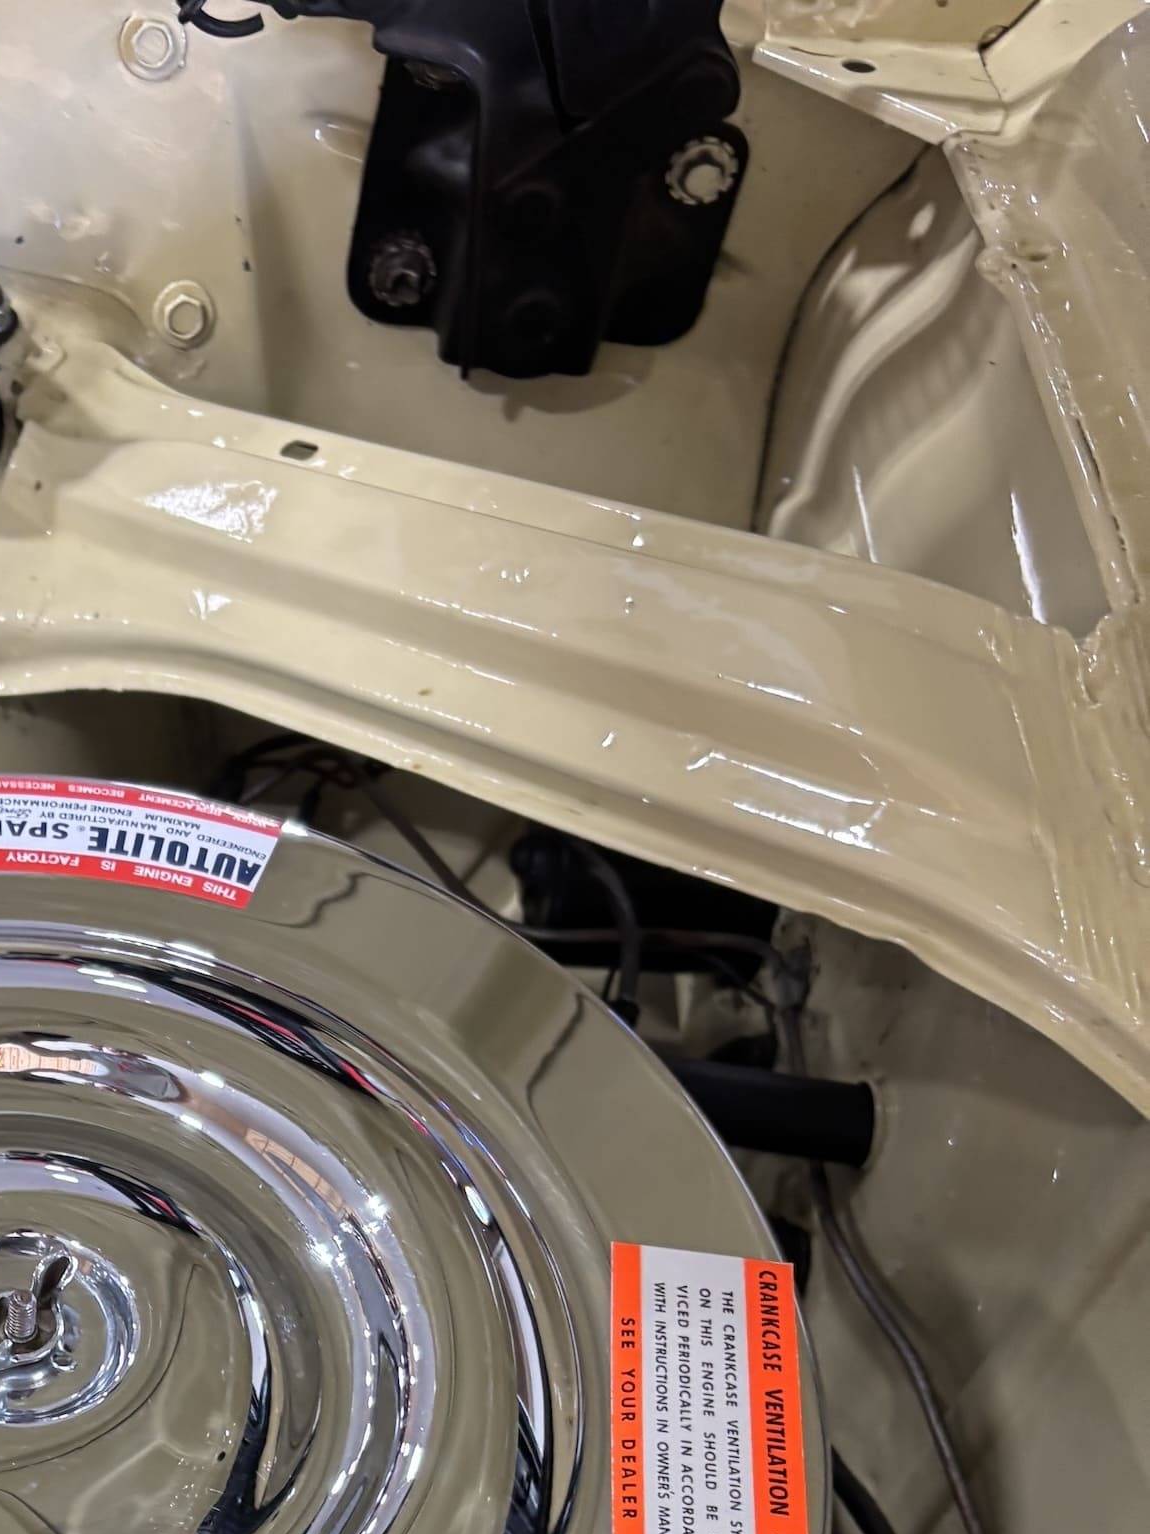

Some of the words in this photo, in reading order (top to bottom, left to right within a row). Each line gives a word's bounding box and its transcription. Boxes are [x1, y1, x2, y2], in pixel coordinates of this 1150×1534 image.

[68, 784, 125, 798] BECOMES
[40, 811, 55, 819] BY
[58, 812, 157, 831] MANUFACTURED
[90, 805, 133, 817] ENGINE
[145, 813, 201, 830] MAXIMUM
[166, 827, 191, 838] AND
[5, 851, 80, 867] FACTORY
[197, 834, 267, 860] ENGINEERED
[100, 860, 116, 872] IS
[133, 865, 194, 887] ENGINE
[202, 881, 237, 901] THIS
[654, 1282, 666, 1313] WITH
[676, 1285, 690, 1328] VICED
[699, 1288, 711, 1308] ON
[722, 1291, 734, 1314] THE
[621, 1317, 635, 1349] SEE
[700, 1319, 713, 1347] THIS
[758, 1270, 782, 1372] CRANKCASE
[655, 1320, 668, 1412] INSTRUCTIONS
[723, 1324, 738, 1407] CRANKCASE
[621, 1369, 635, 1421] YOUR
[677, 1335, 692, 1432] PERIODICALLY
[702, 1362, 715, 1417] ENGINE
[657, 1419, 669, 1433] IN
[680, 1440, 692, 1456] IN
[704, 1432, 717, 1490] SHOULD
[764, 1389, 790, 1516] VENTILATION
[657, 1441, 675, 1499] OWNER'S
[727, 1420, 742, 1511] VENTILATION
[622, 1439, 637, 1519] DEALER
[706, 1505, 718, 1521] BE
